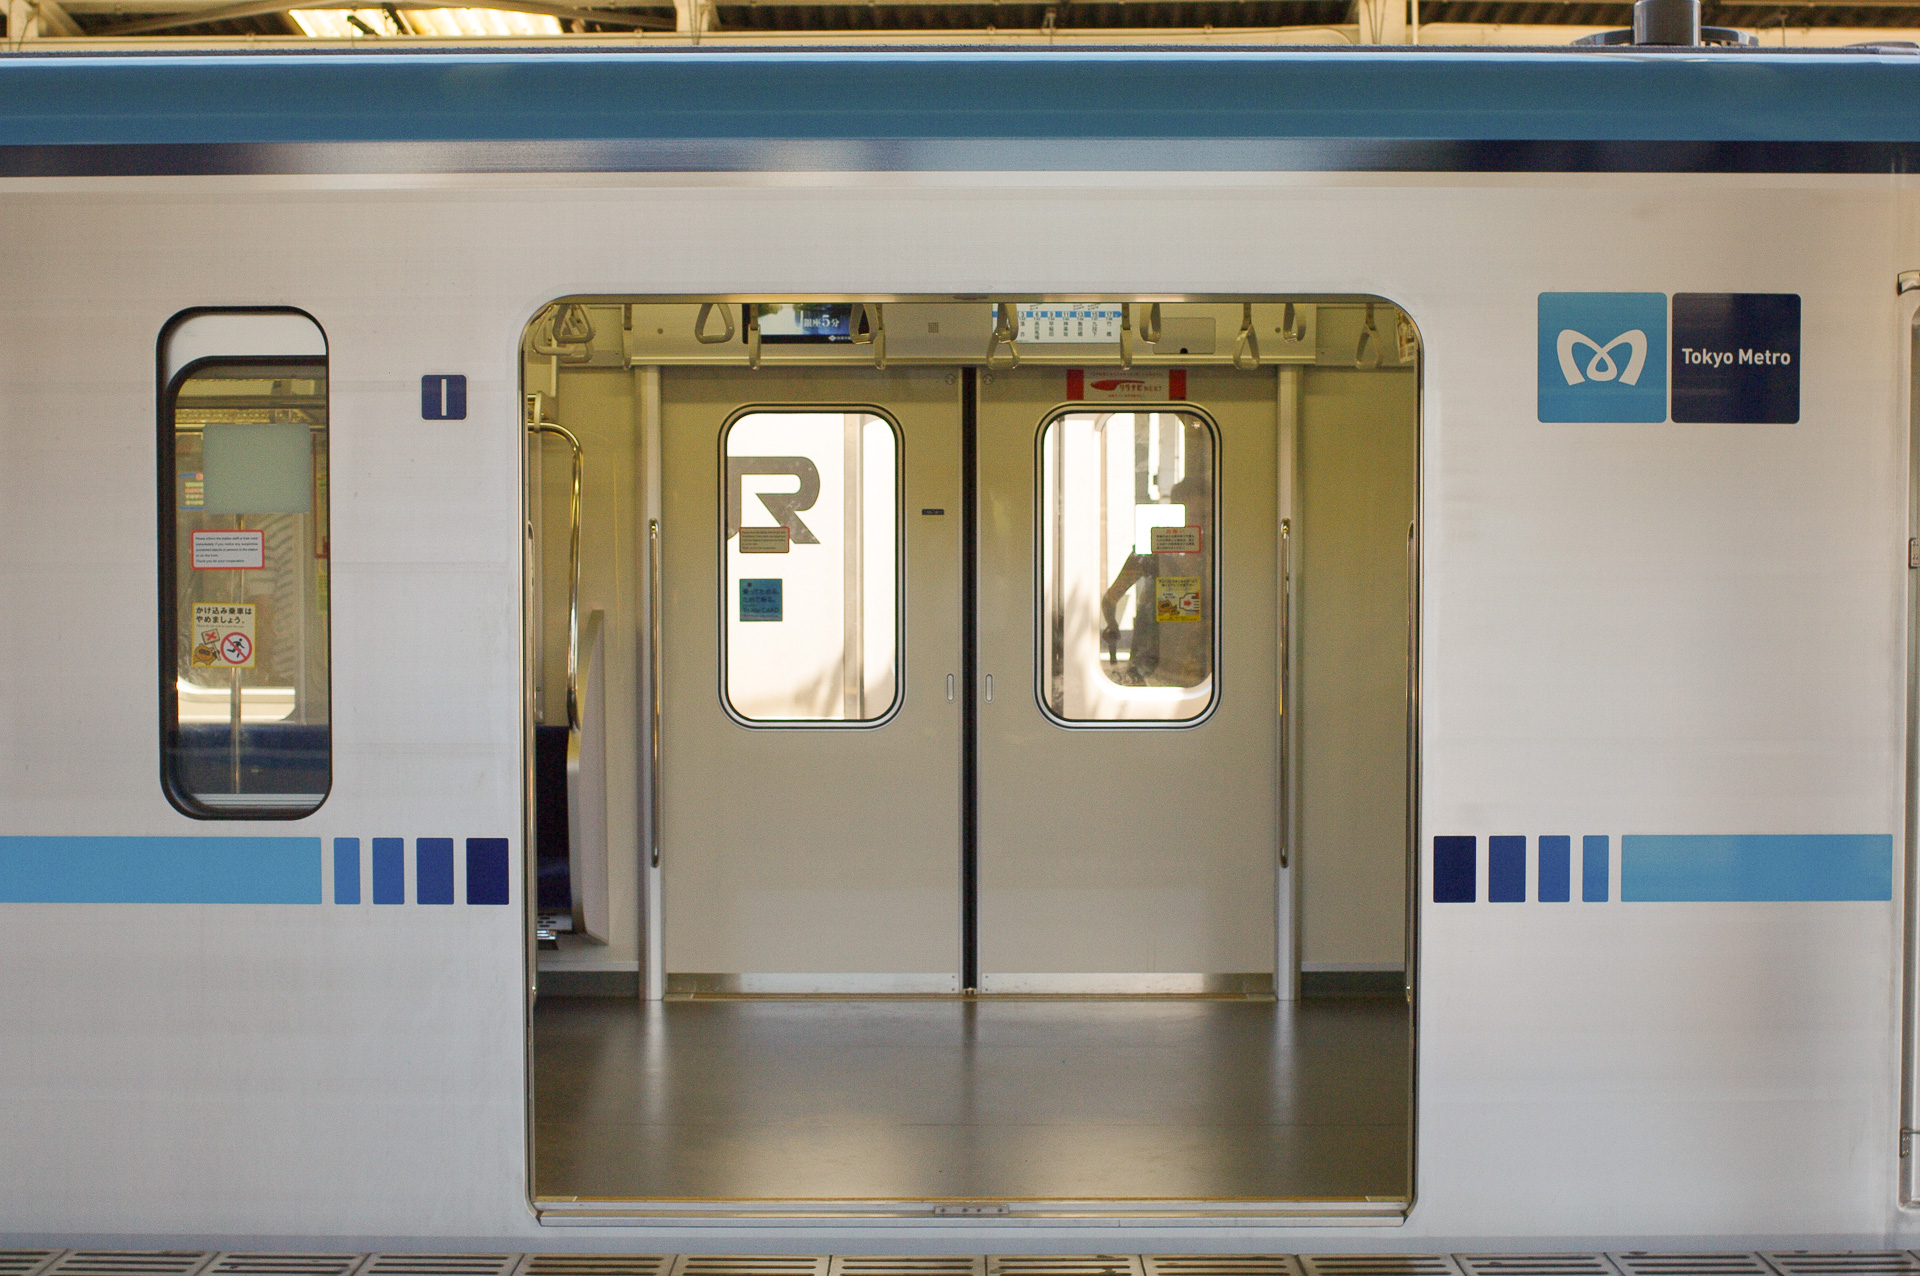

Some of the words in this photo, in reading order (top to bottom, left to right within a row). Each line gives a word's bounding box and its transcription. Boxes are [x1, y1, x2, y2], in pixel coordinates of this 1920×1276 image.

[1681, 347, 1734, 368] Tokyo
[1738, 348, 1791, 366] Metro
[196, 616, 245, 624] やめましょう。
